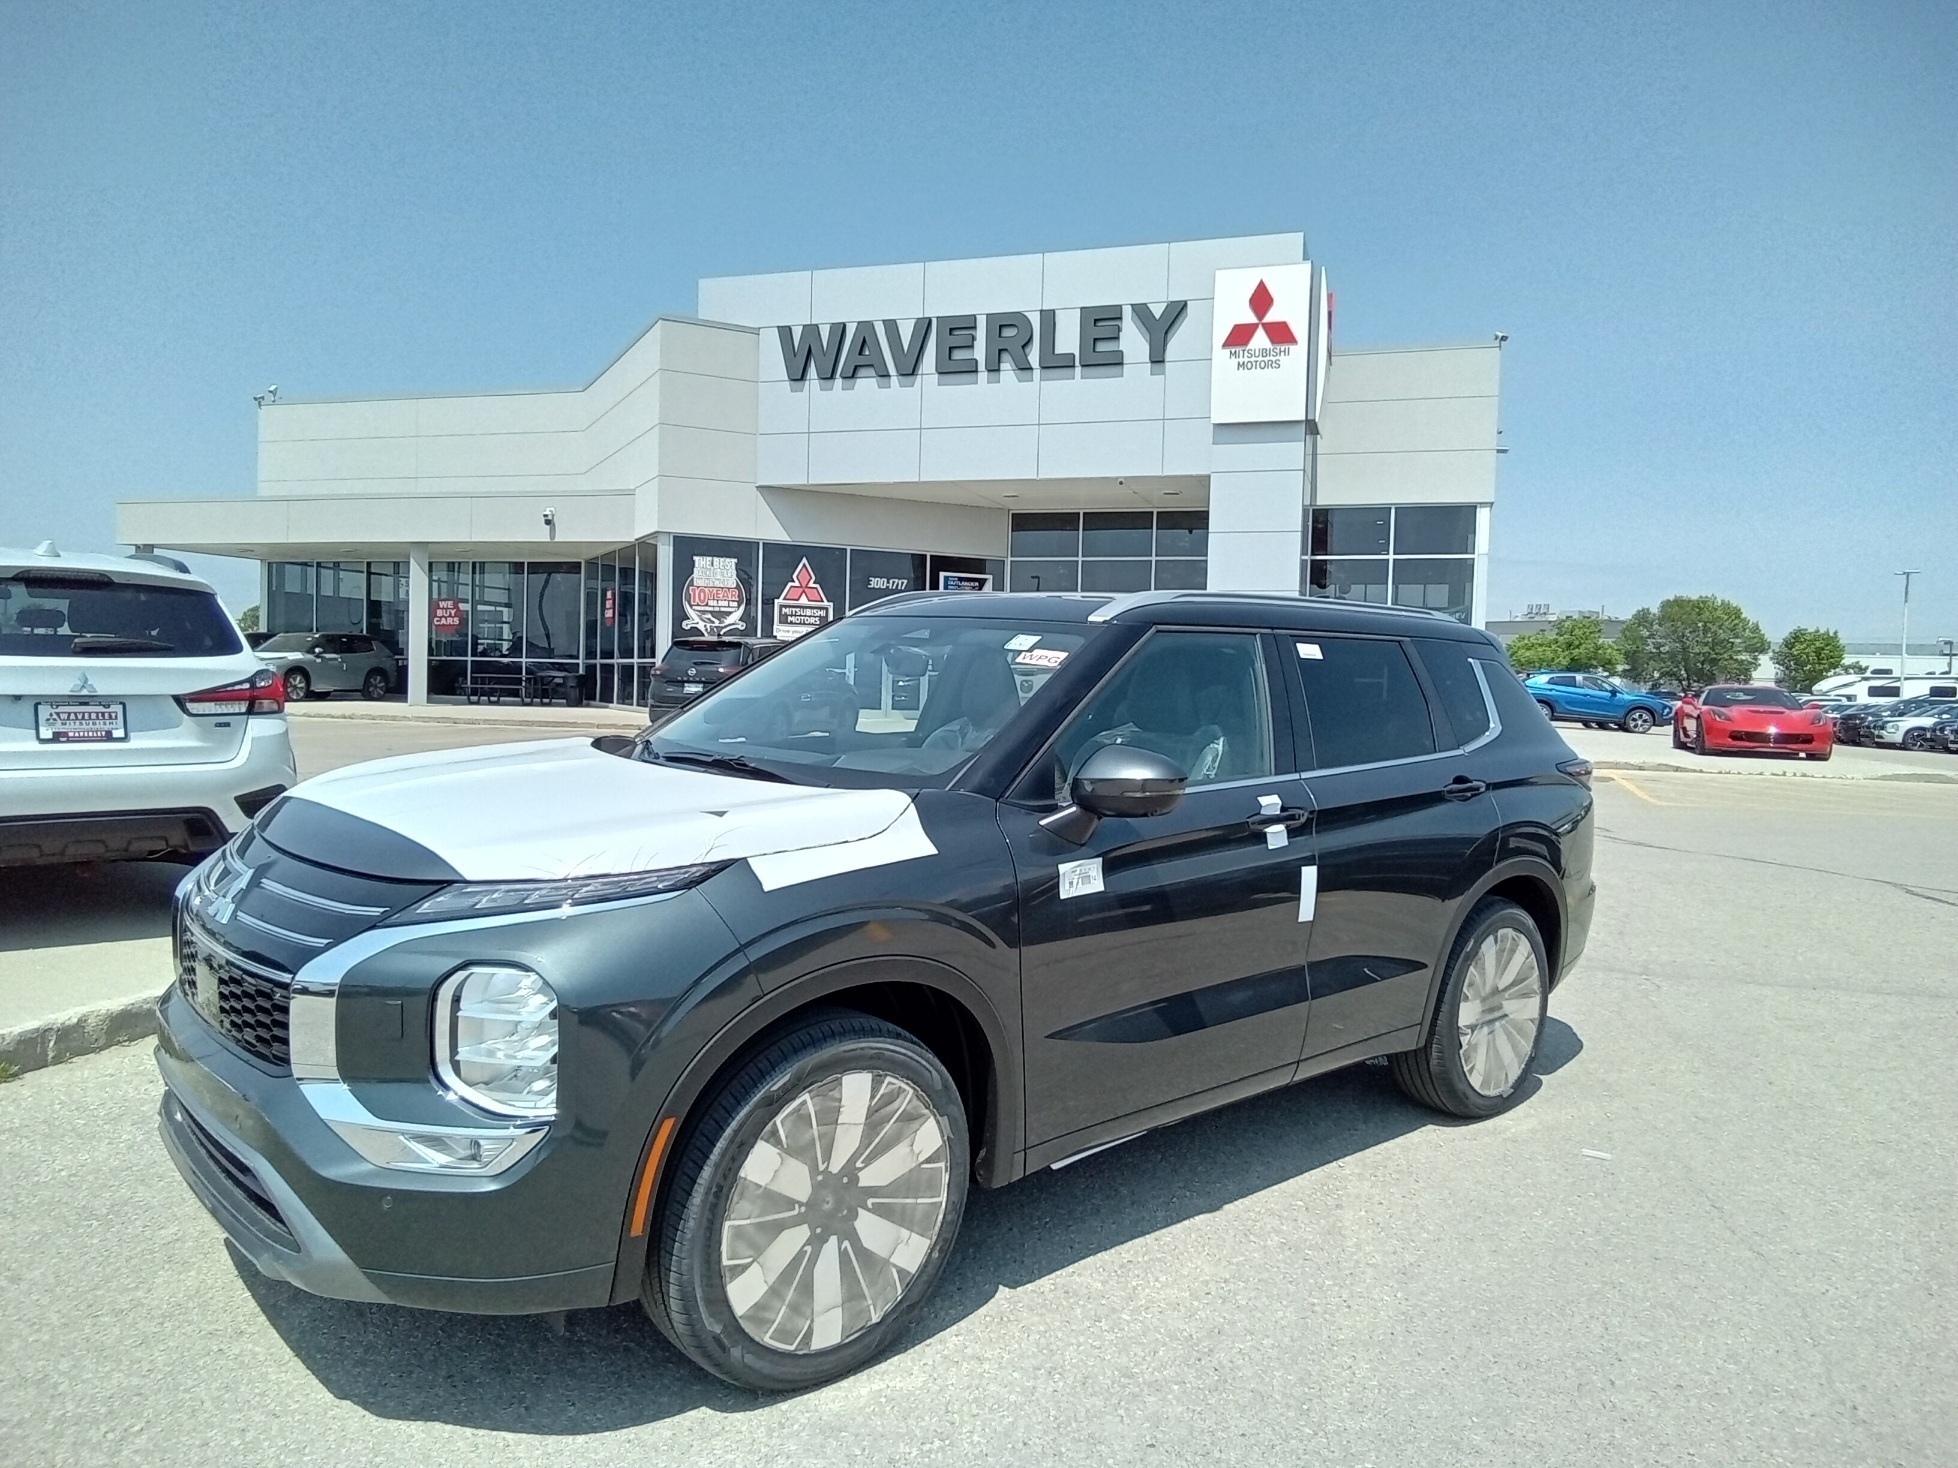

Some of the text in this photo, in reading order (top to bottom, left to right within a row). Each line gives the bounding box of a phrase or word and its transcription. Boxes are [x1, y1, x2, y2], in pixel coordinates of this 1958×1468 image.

[777, 301, 1187, 381] WAVERLEY
[1229, 347, 1290, 359] MITSUBISHI
[1237, 359, 1281, 371] MOTORS
[693, 556, 737, 569] THE BEST
[867, 577, 908, 590] 300-1717
[690, 587, 739, 605] 10 YEAR
[439, 600, 454, 608] WE
[436, 609, 457, 617] BUY
[781, 607, 826, 617] MITSUBISHI
[433, 617, 460, 625] CARS
[787, 616, 820, 624] MOTORS
[1022, 653, 1060, 664] WPG
[60, 712, 117, 720] WAVERLEY
